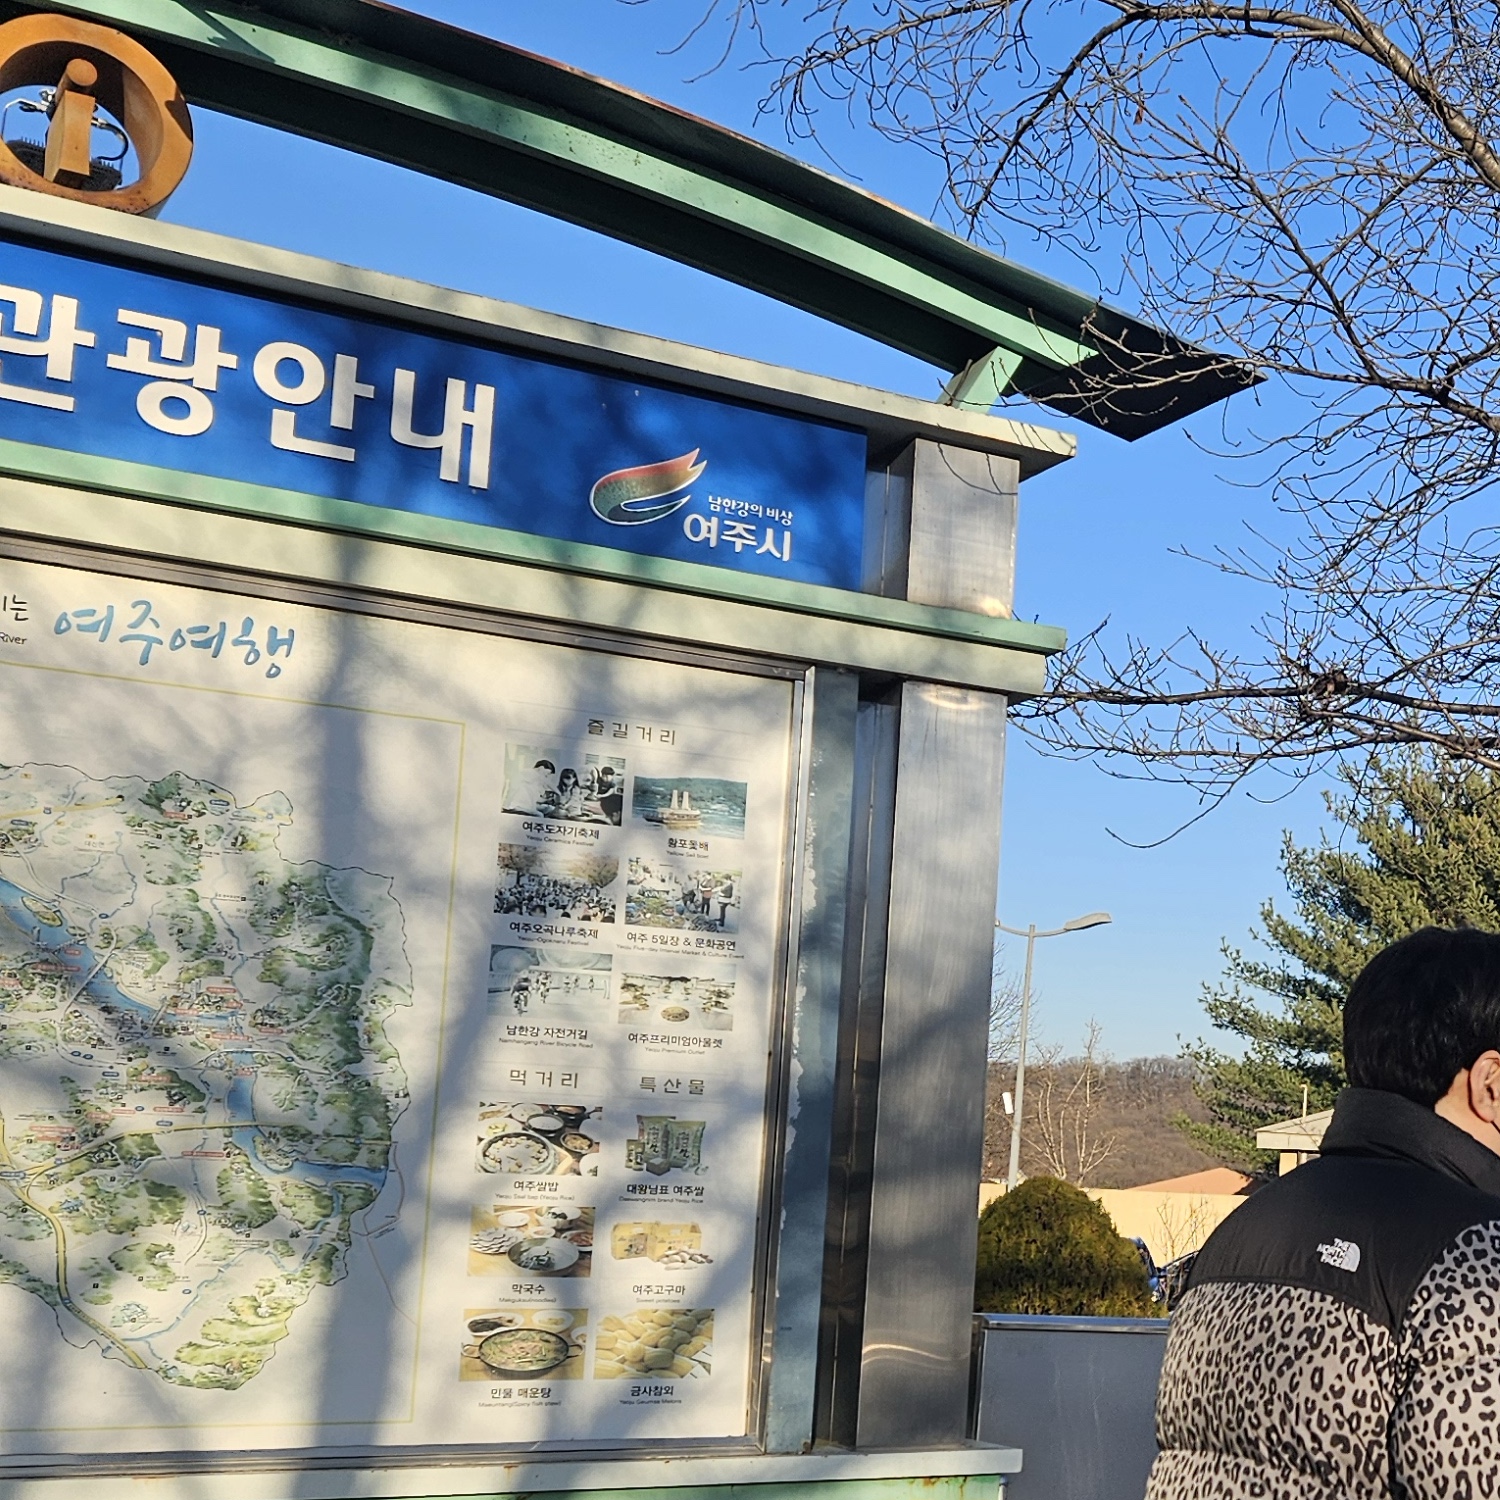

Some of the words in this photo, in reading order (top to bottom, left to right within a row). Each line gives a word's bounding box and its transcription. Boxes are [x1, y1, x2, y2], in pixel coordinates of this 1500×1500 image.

[708, 495, 763, 518] 남한강의
[766, 507, 793, 526] 비상
[683, 513, 791, 562] 여주시
[522, 821, 600, 840] 여주도자기축제
[509, 922, 599, 939] 여주오곡나루축제
[626, 931, 648, 943] 여주
[651, 934, 680, 947] 5일장
[682, 937, 692, 947] &
[695, 937, 736, 951] 문화공연
[506, 1024, 541, 1038] 남한강
[543, 1027, 588, 1041] 자전거길
[628, 1032, 723, 1049] 여주프리미엄아울렛
[626, 1183, 669, 1195] 대왕님표
[672, 1185, 704, 1197] 여주쌀
[512, 1283, 546, 1295] 막국수
[632, 1284, 686, 1296] 여주고구마
[631, 1385, 674, 1397] 금사참외
